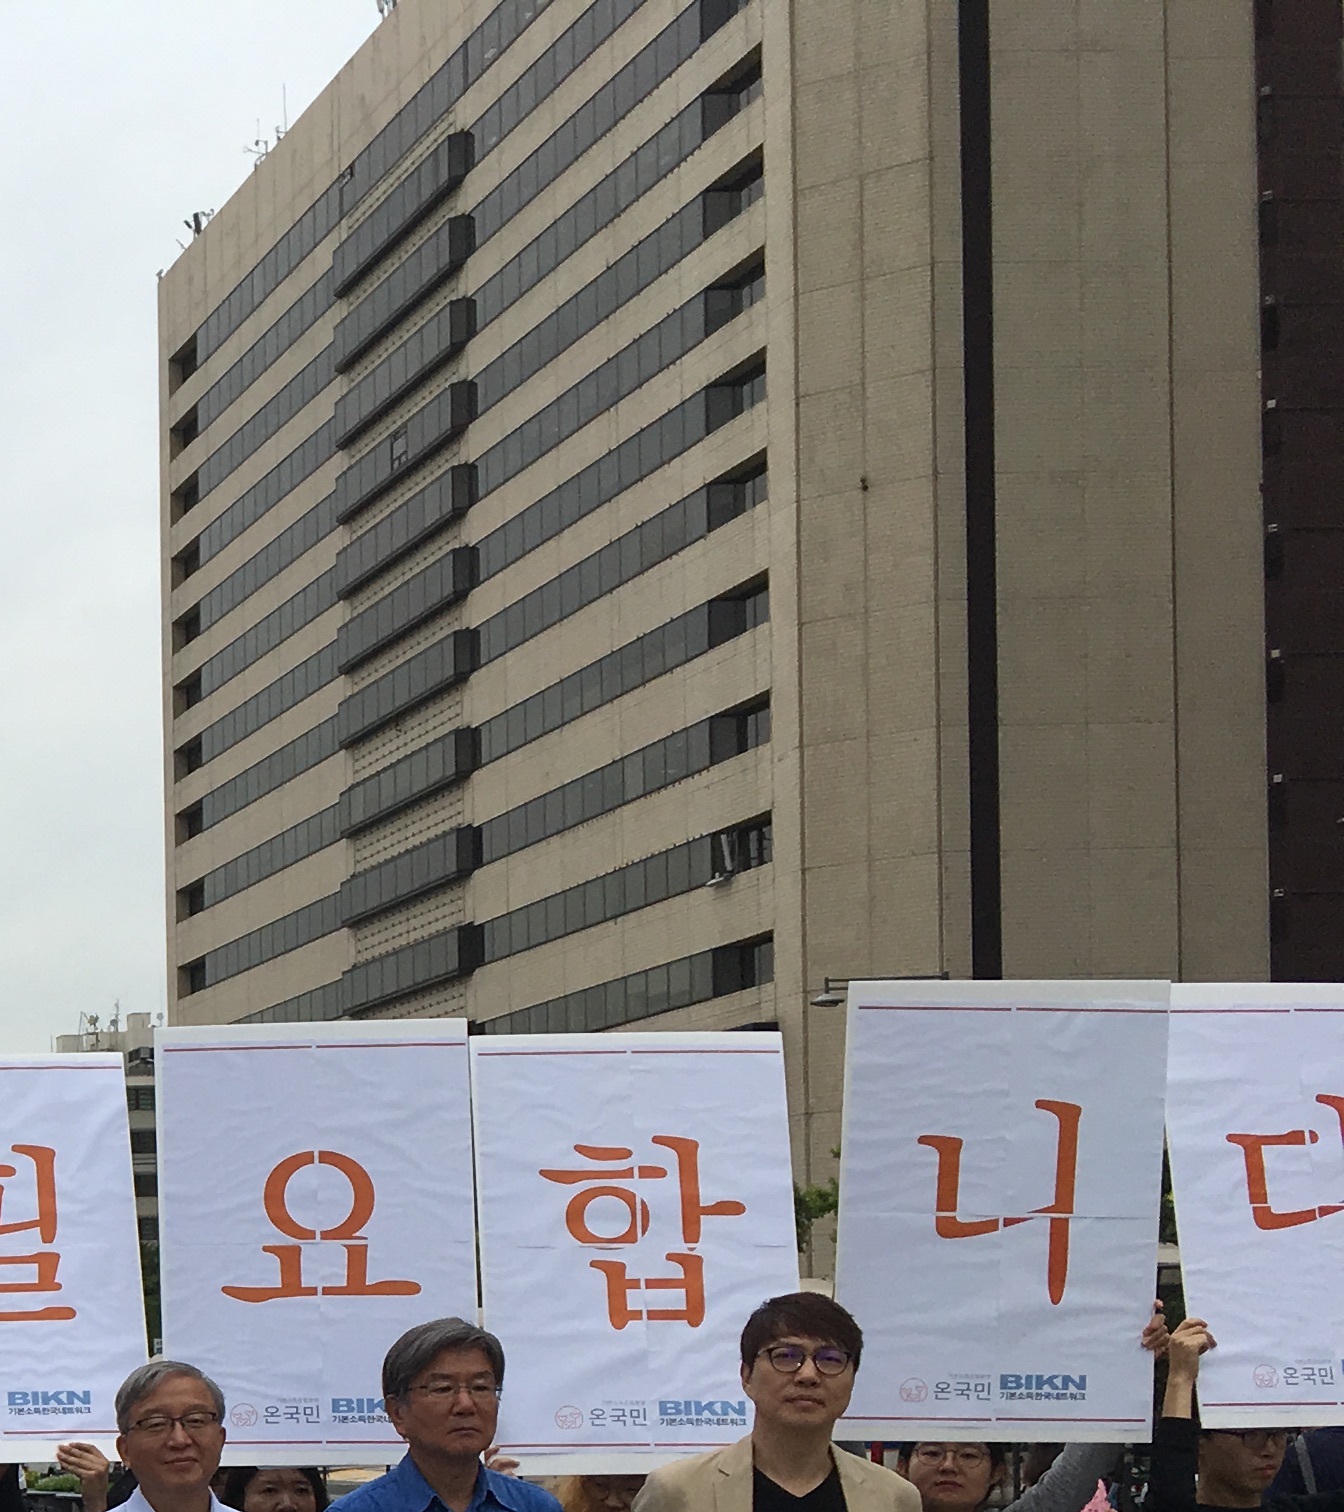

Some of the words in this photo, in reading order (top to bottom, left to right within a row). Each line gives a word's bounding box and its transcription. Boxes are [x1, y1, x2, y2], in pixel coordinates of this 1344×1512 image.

[917, 1099, 1082, 1305] 니
[220, 1150, 422, 1303] 요
[538, 1135, 746, 1330] 합
[1000, 1374, 1087, 1391] BIKN
[1283, 1366, 1334, 1386] 온국민
[7, 1390, 91, 1406] BIKN
[934, 1381, 991, 1401] 온국민
[1000, 1391, 1087, 1401] 기본소득한국네트워크
[9, 1407, 91, 1416] 기본소득한국네트워크
[263, 1404, 320, 1424] 온국민
[331, 1398, 386, 1414] BIK
[658, 1400, 746, 1416] BIKN
[589, 1407, 647, 1427] 온국민
[660, 1417, 747, 1427] 기본소득한국네트워크
